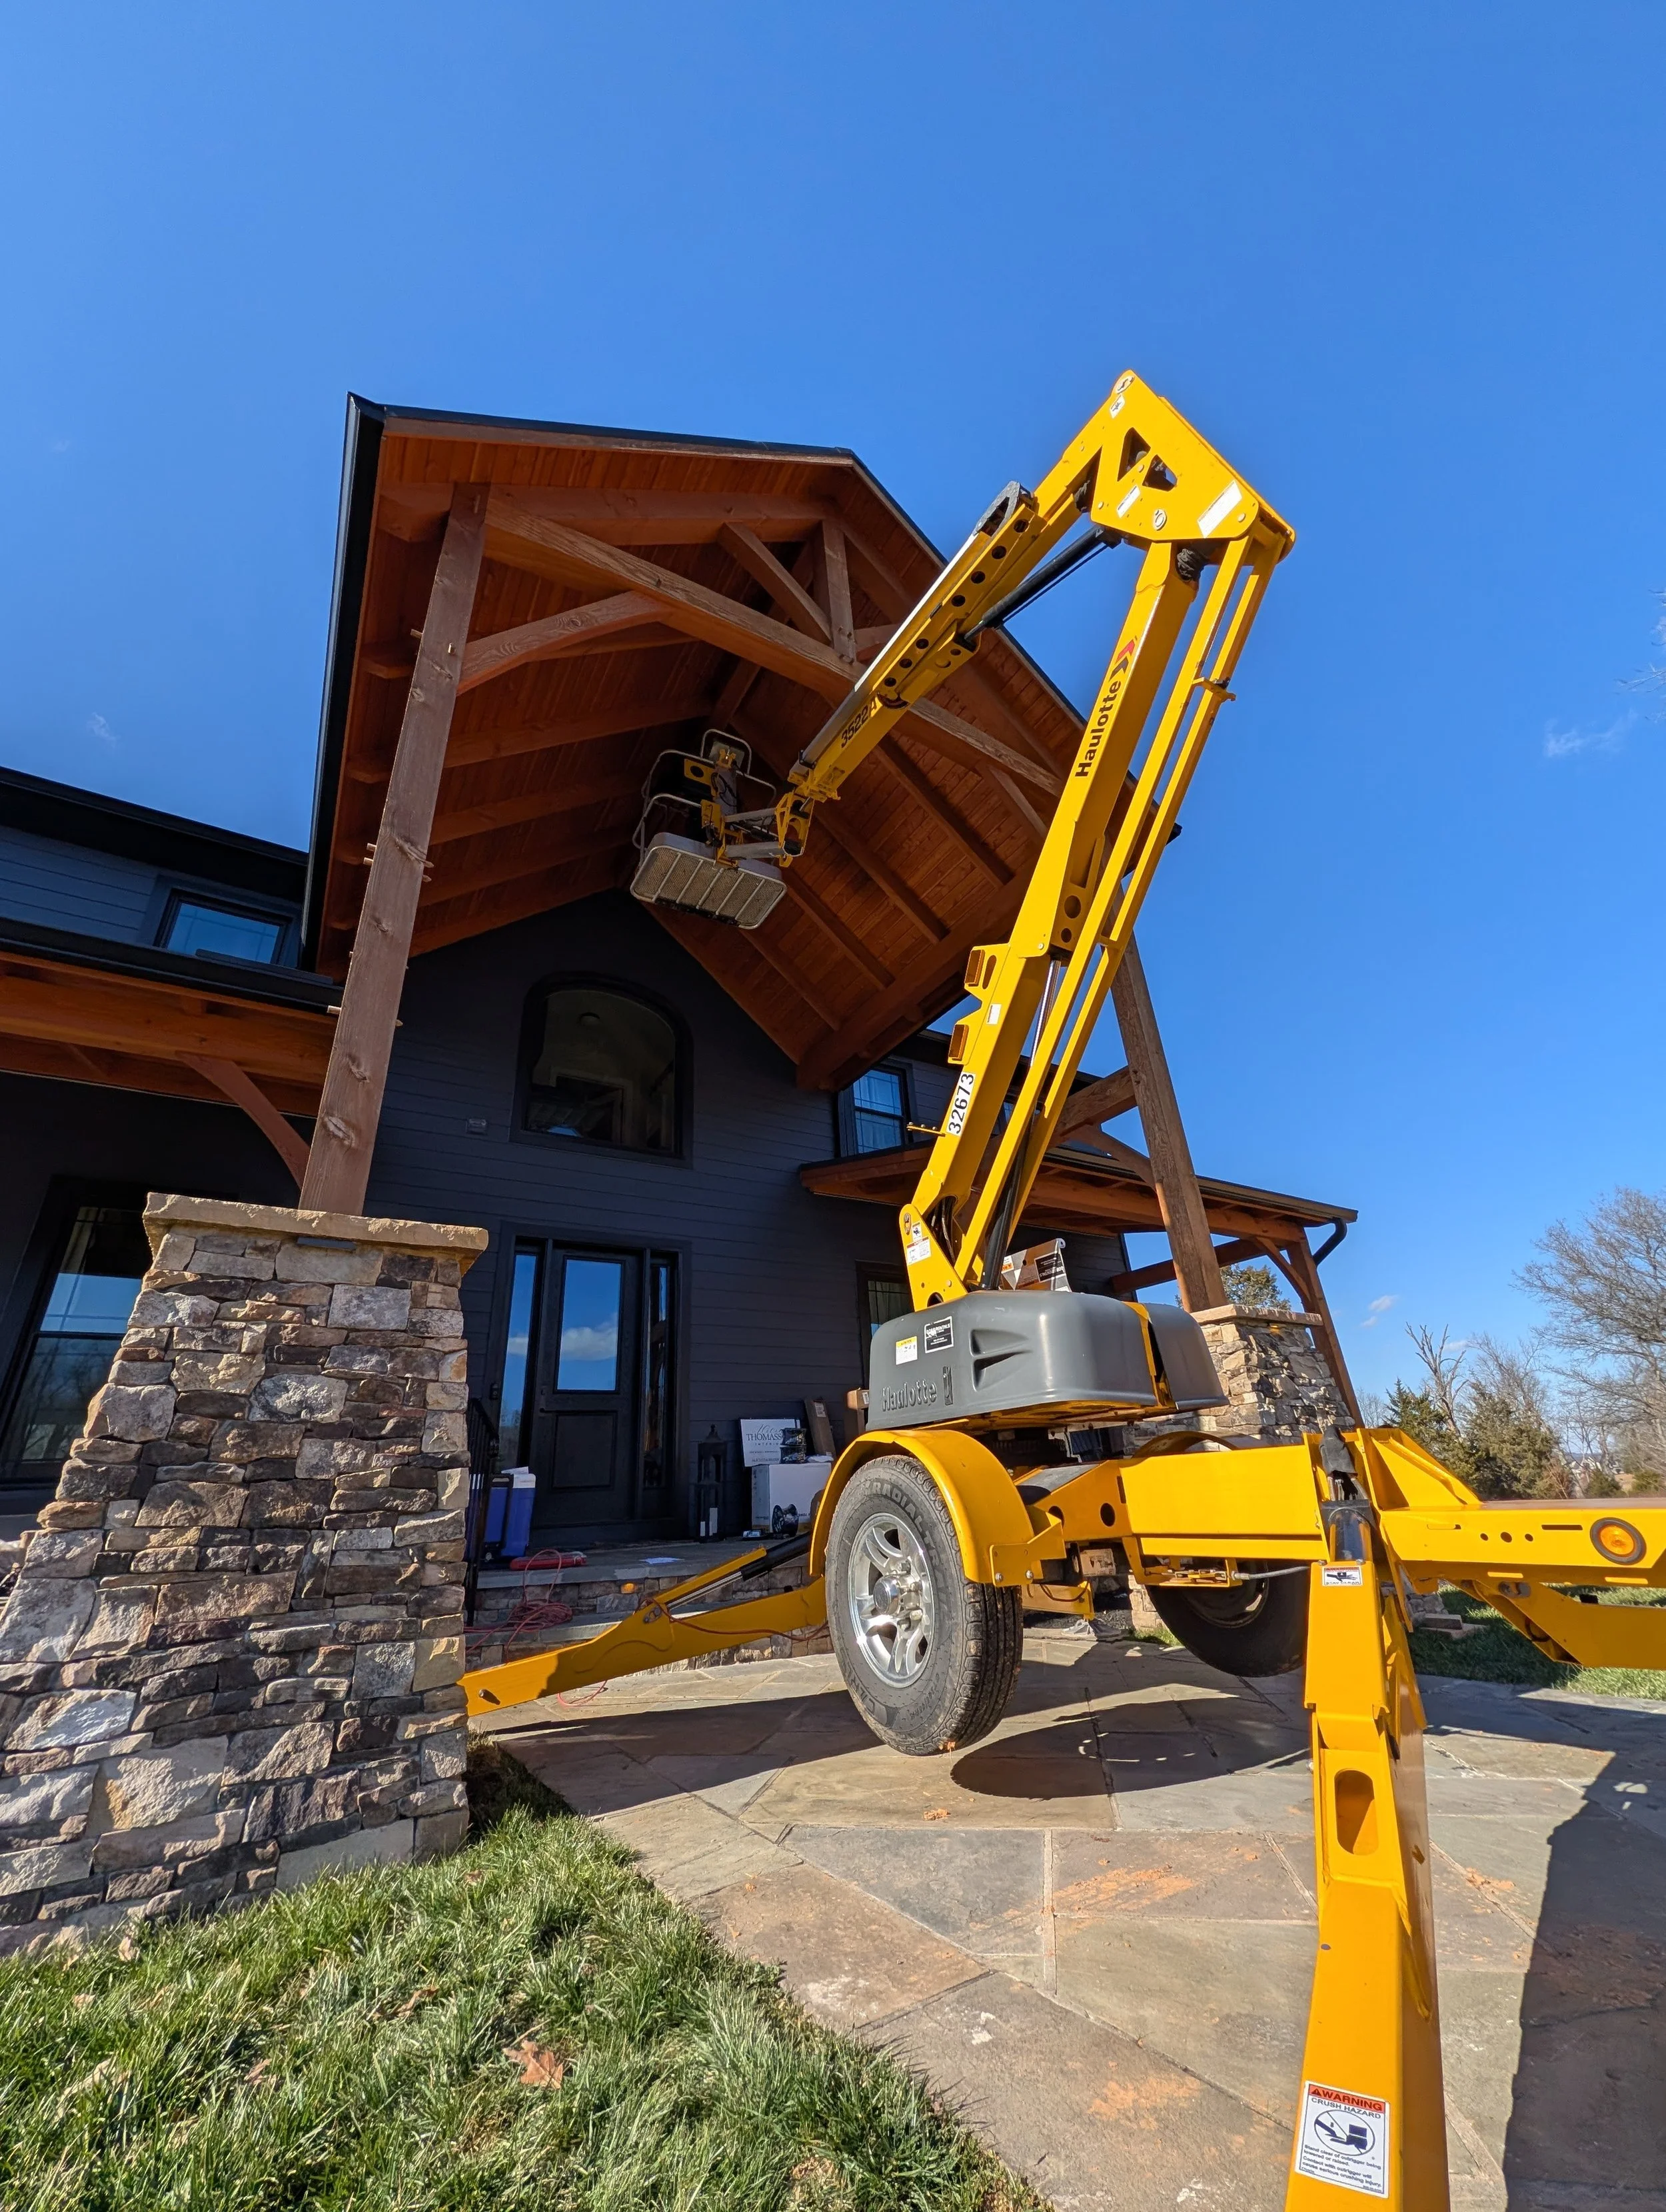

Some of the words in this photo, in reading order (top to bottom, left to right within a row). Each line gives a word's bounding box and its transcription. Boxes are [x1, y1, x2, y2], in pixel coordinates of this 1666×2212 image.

[841, 696, 878, 748] 3522A
[1075, 680, 1122, 777] Haulotte
[948, 1073, 974, 1134] 32673
[882, 1379, 937, 1412] Haulotte
[871, 1482, 923, 1532] RADIAL
[1311, 2097, 1341, 2109] CRUSH
[1344, 2104, 1381, 2119] HAZARD
[1321, 2089, 1382, 2111] WARNING
[1303, 2149, 1324, 2159] lowered
[1341, 2155, 1365, 2165] outrigger
[1303, 2156, 1323, 2165] Contact
[1337, 2166, 1361, 2176] outrigger
[1319, 2167, 1339, 2176] serious
[1340, 2173, 1363, 2183] crushing
